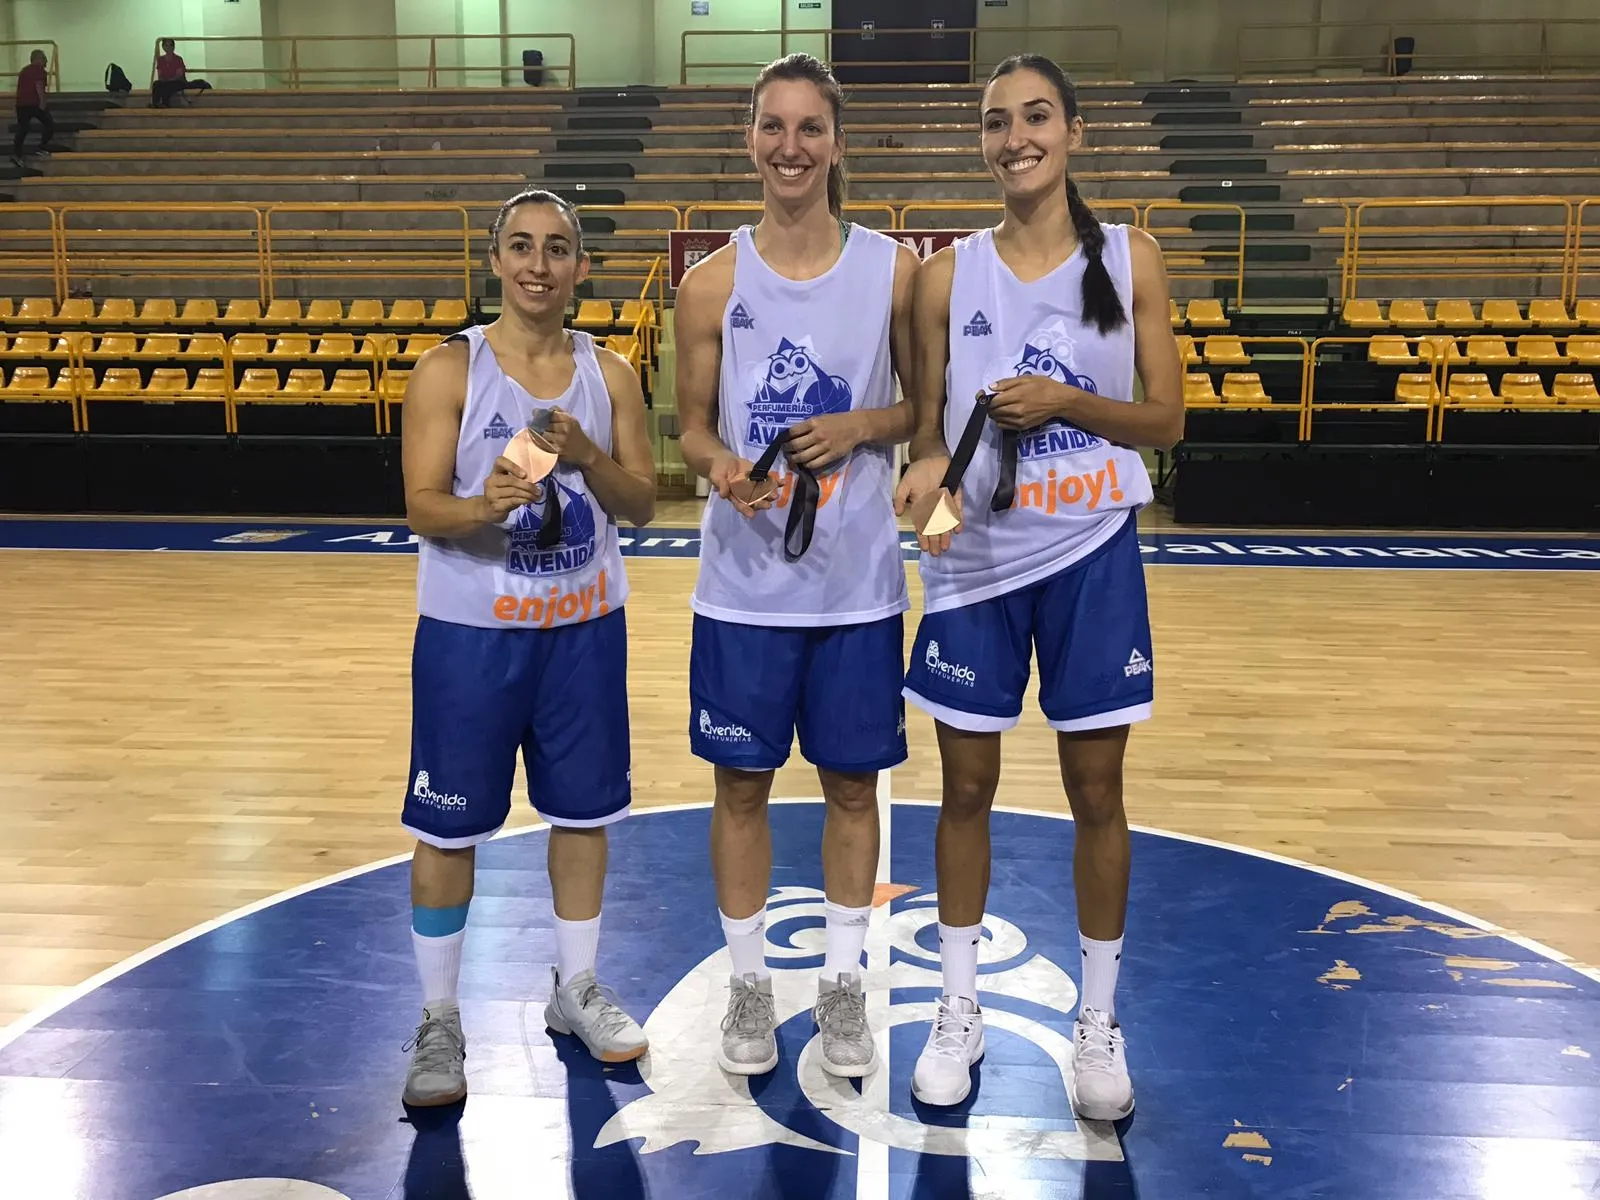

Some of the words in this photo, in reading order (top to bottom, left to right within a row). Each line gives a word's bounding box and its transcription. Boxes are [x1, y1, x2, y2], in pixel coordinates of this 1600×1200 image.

[963, 323, 993, 337] PEAK
[752, 403, 812, 413] PERFUMERÍAS
[484, 427, 514, 440] PEAK
[1017, 429, 1100, 458] VENIDA
[493, 567, 609, 629] enjoy!
[1123, 659, 1153, 678] PEAK
